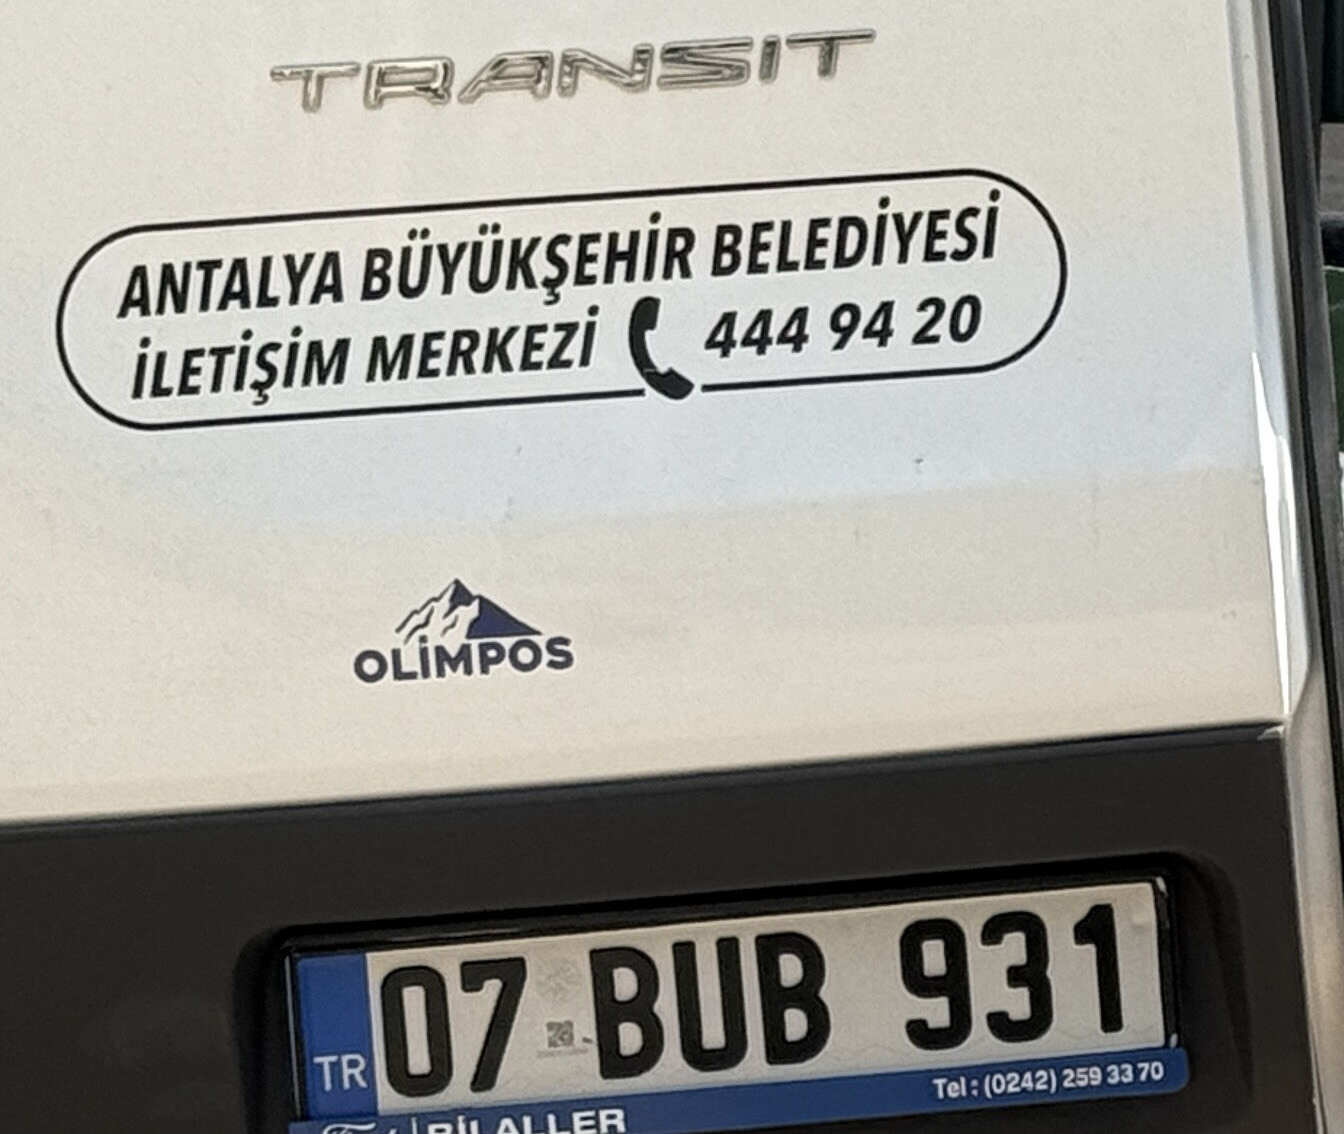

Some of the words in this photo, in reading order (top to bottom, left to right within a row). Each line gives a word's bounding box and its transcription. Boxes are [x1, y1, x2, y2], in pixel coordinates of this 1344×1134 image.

[270, 28, 876, 113] TRANSIT
[117, 251, 344, 318] ANTALYA
[360, 211, 695, 304] BÜYÜKŞEHİR
[709, 188, 1001, 278] BELEDİYESİ
[132, 325, 350, 406] İLETİŞİM
[365, 305, 599, 384] MERKEZİ
[705, 307, 809, 358] 444
[829, 301, 896, 351] 94
[912, 294, 982, 345] 20
[354, 632, 574, 683] OLİMPOS
[379, 956, 528, 1098] 07
[589, 930, 832, 1081] BUB
[897, 901, 1126, 1051] 931
[313, 1053, 368, 1092] TR
[984, 1069, 1057, 1099] (0242)
[1062, 1066, 1102, 1089] 259
[1106, 1064, 1134, 1085] 33
[1137, 1061, 1165, 1081] 70
